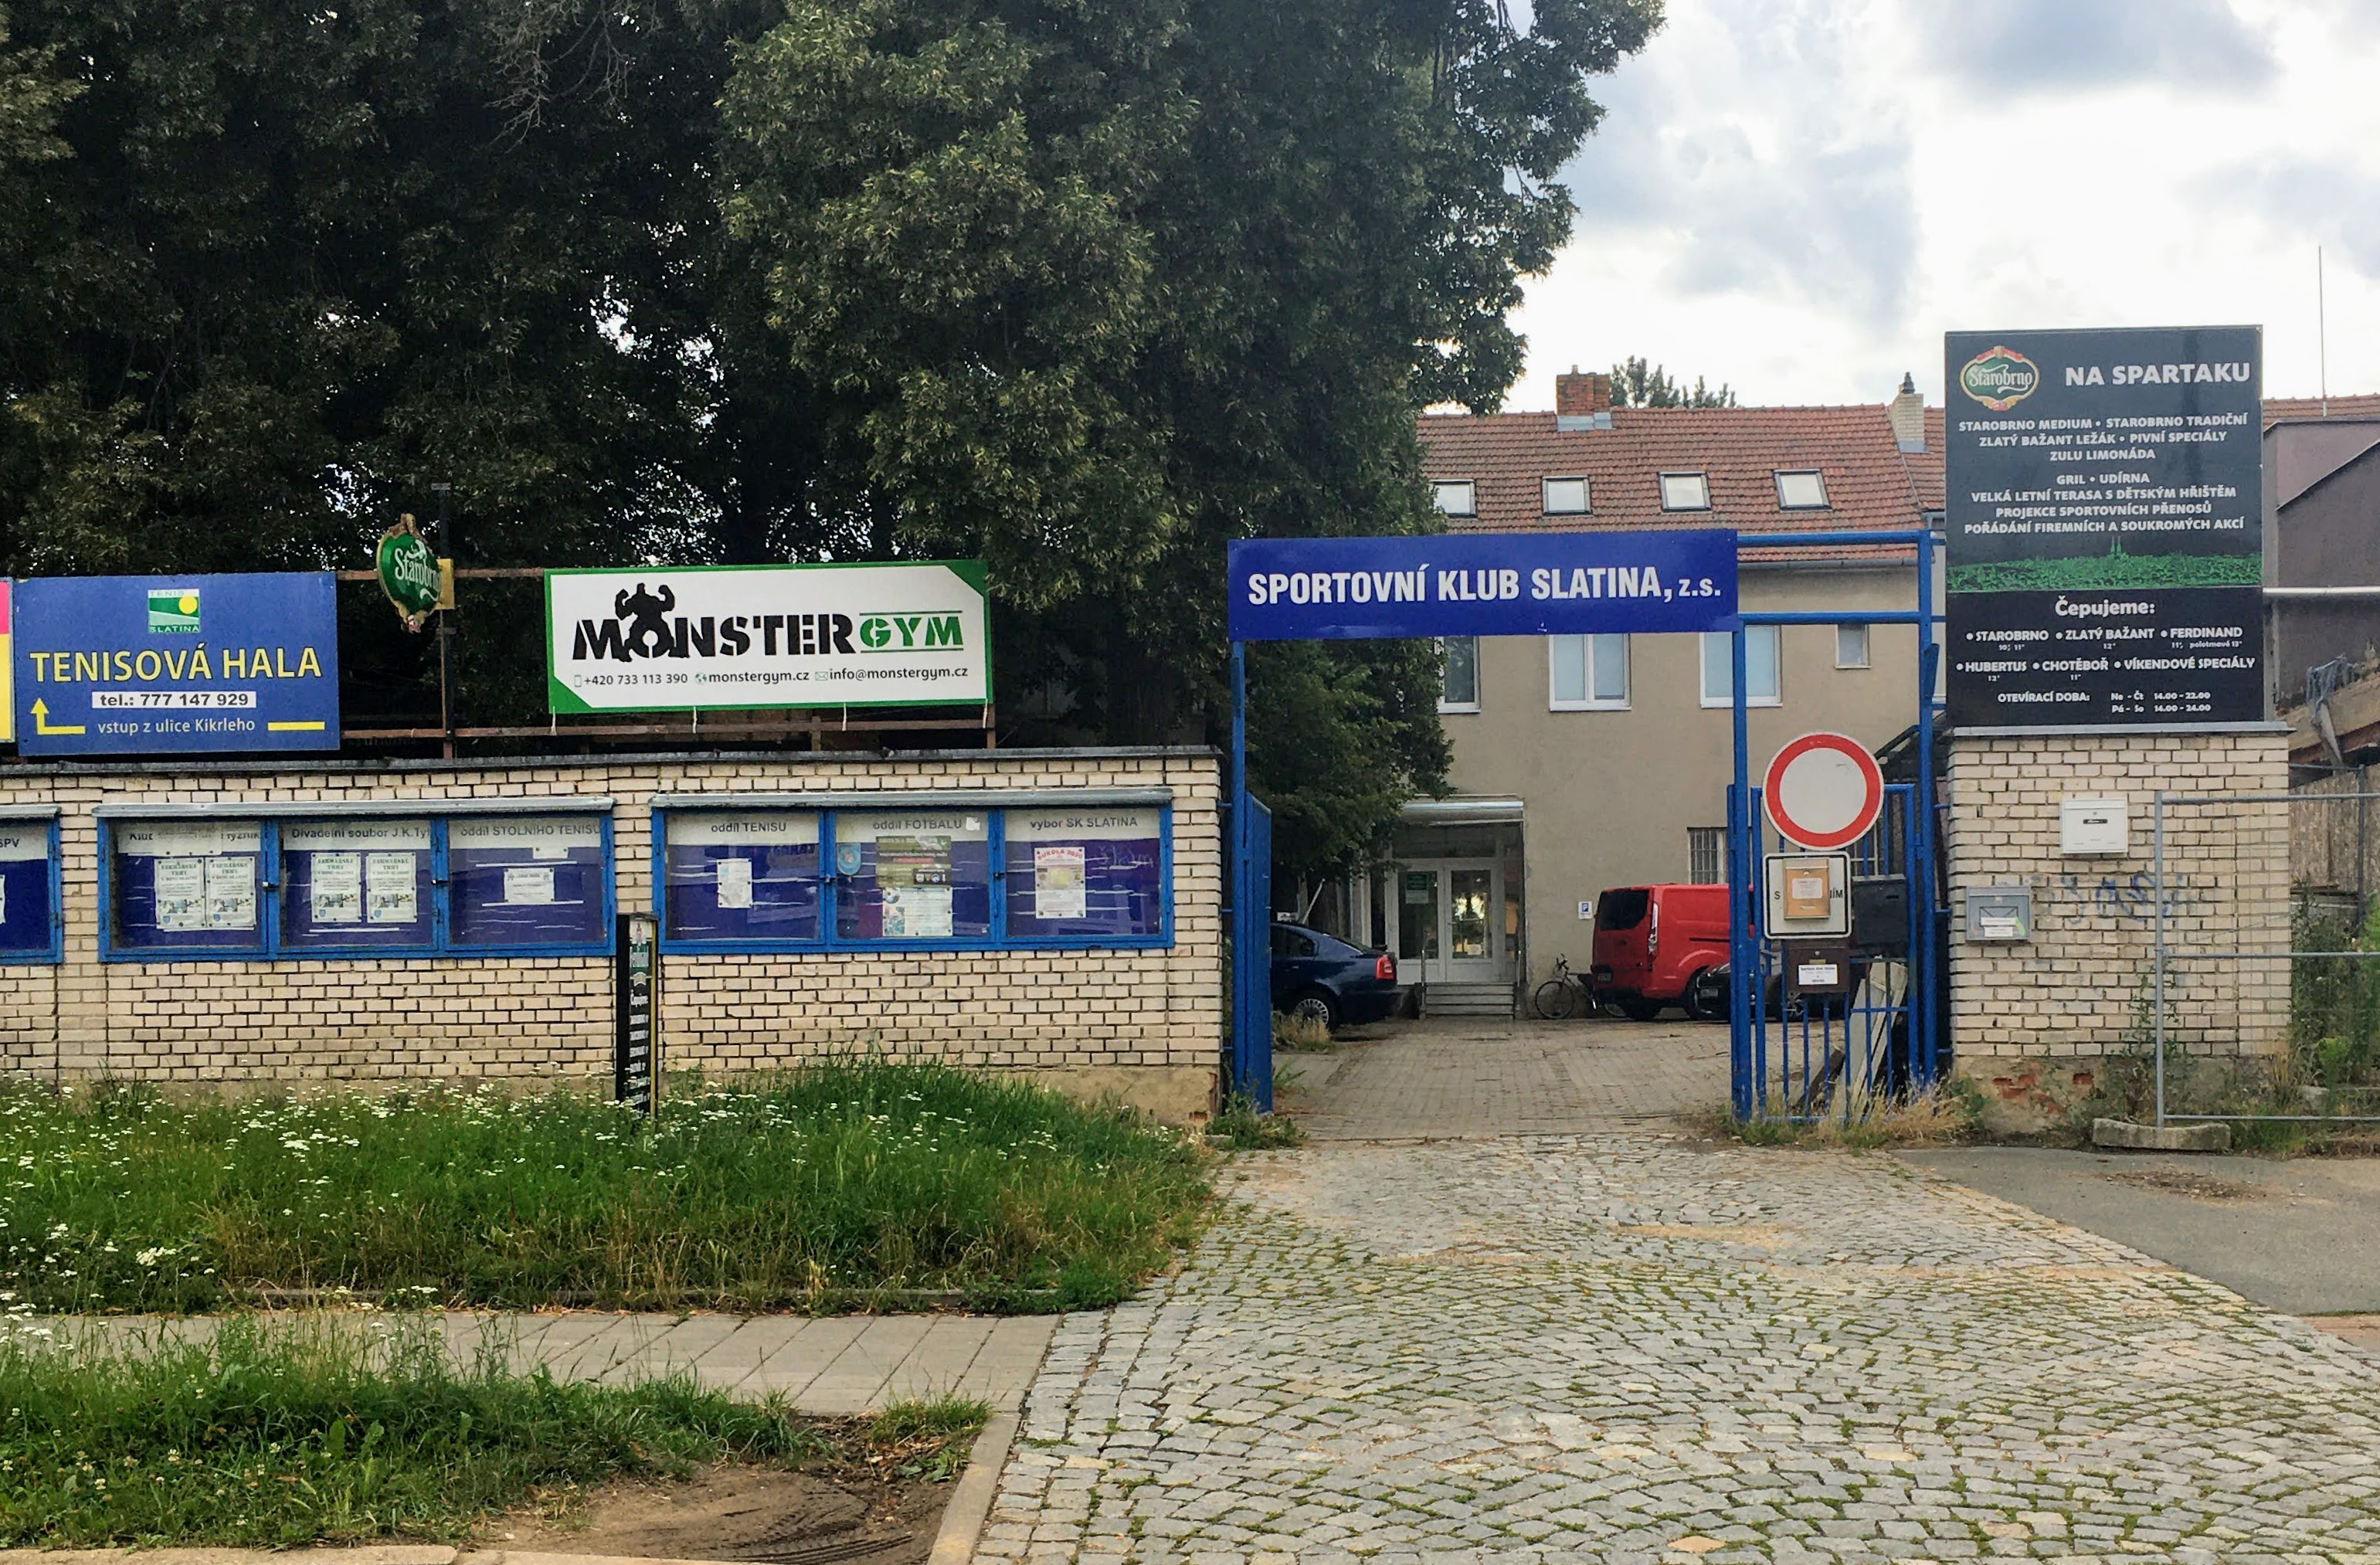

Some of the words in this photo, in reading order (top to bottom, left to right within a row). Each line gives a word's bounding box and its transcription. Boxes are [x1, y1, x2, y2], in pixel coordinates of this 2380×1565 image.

[1969, 364, 2032, 394] Starobrno
[2066, 367, 2104, 386] NA
[2112, 362, 2250, 385] SPARTAKU
[1959, 420, 2035, 432] STAROBRNO
[2039, 419, 2092, 430] MEDIUM
[2107, 417, 2183, 428] STAROBRNO
[2186, 412, 2247, 426] TRADIČNÍ
[1979, 434, 2018, 446] ZLATÝ
[2022, 433, 2073, 445] BAŽANT
[2076, 432, 2116, 445] LEŽÁK
[2130, 430, 2165, 443] PIVNÍ
[2168, 430, 2227, 443] SPECIÁLY
[2050, 450, 2082, 461] ZULU
[2086, 447, 2156, 460] LIMONÁDA
[2057, 474, 2086, 485] GRIL
[2100, 471, 2150, 484] UDÍRNA
[1971, 490, 2012, 503] VELKÁ
[2015, 489, 2051, 502] LETNÍ
[2054, 490, 2102, 501] TERASA
[2105, 490, 2113, 501] S
[2117, 487, 2175, 500] DĚTSKÝM
[2180, 485, 2236, 498] HŘIŠTĚM
[1996, 507, 2056, 519] PROJEKCE
[2059, 504, 2148, 516] SPORTOVNÍCH
[2152, 500, 2212, 514] PŘENOSŮ
[1965, 521, 2031, 535] POŘÁDÁNÍ
[2035, 519, 2104, 533] FIREMNÍCH
[2108, 521, 2118, 531] A
[2121, 518, 2210, 531] SOUKROMÝCH
[2214, 517, 2244, 529] AKCÍ
[1248, 564, 1429, 605] SPORTOVNÍ
[1438, 569, 1519, 601] KLUB
[1531, 567, 1672, 603] SLATINA,
[1678, 580, 1721, 597] z.s.
[2055, 596, 2155, 619] Čepujeme:
[1976, 630, 2049, 641] STAROBRNO
[2065, 627, 2103, 640] ZLATÝ
[2106, 626, 2154, 639] BAŽANT
[2171, 627, 2243, 638] FERDINAND
[29, 642, 212, 683] TENISOVÁ
[222, 647, 322, 677] HALA
[1965, 661, 2027, 672] HUBERTUS
[2042, 657, 2108, 671] CHOTĚBOŘ
[2124, 656, 2195, 670] VÍKENDOVÉ
[2198, 656, 2255, 669] SPECIÁLY
[584, 675, 613, 685] +420
[618, 674, 638, 684] 733
[643, 674, 662, 684] 113
[666, 674, 688, 684] 390
[708, 670, 809, 685] monstergym.cz
[830, 667, 968, 681] info@monstergym.cz
[100, 693, 134, 706] tel.:
[140, 694, 175, 706] 777
[179, 694, 211, 706] 147
[216, 694, 248, 706] 929
[1998, 691, 2054, 703] OTEVÍRACÍ
[2056, 693, 2090, 702] DOBA:
[2134, 690, 2144, 700] Čt
[2112, 704, 2124, 713] Pá
[2134, 704, 2144, 713] So
[98, 721, 138, 736] vstup
[143, 724, 151, 733] z
[155, 719, 190, 732] ulice
[195, 718, 255, 732] Kikrleho
[742, 822, 786, 832] TENISU
[905, 820, 962, 829] FOTBALU
[1067, 818, 1083, 827] SK
[1087, 817, 1137, 827] SLATINA
[348, 828, 388, 837] soubor
